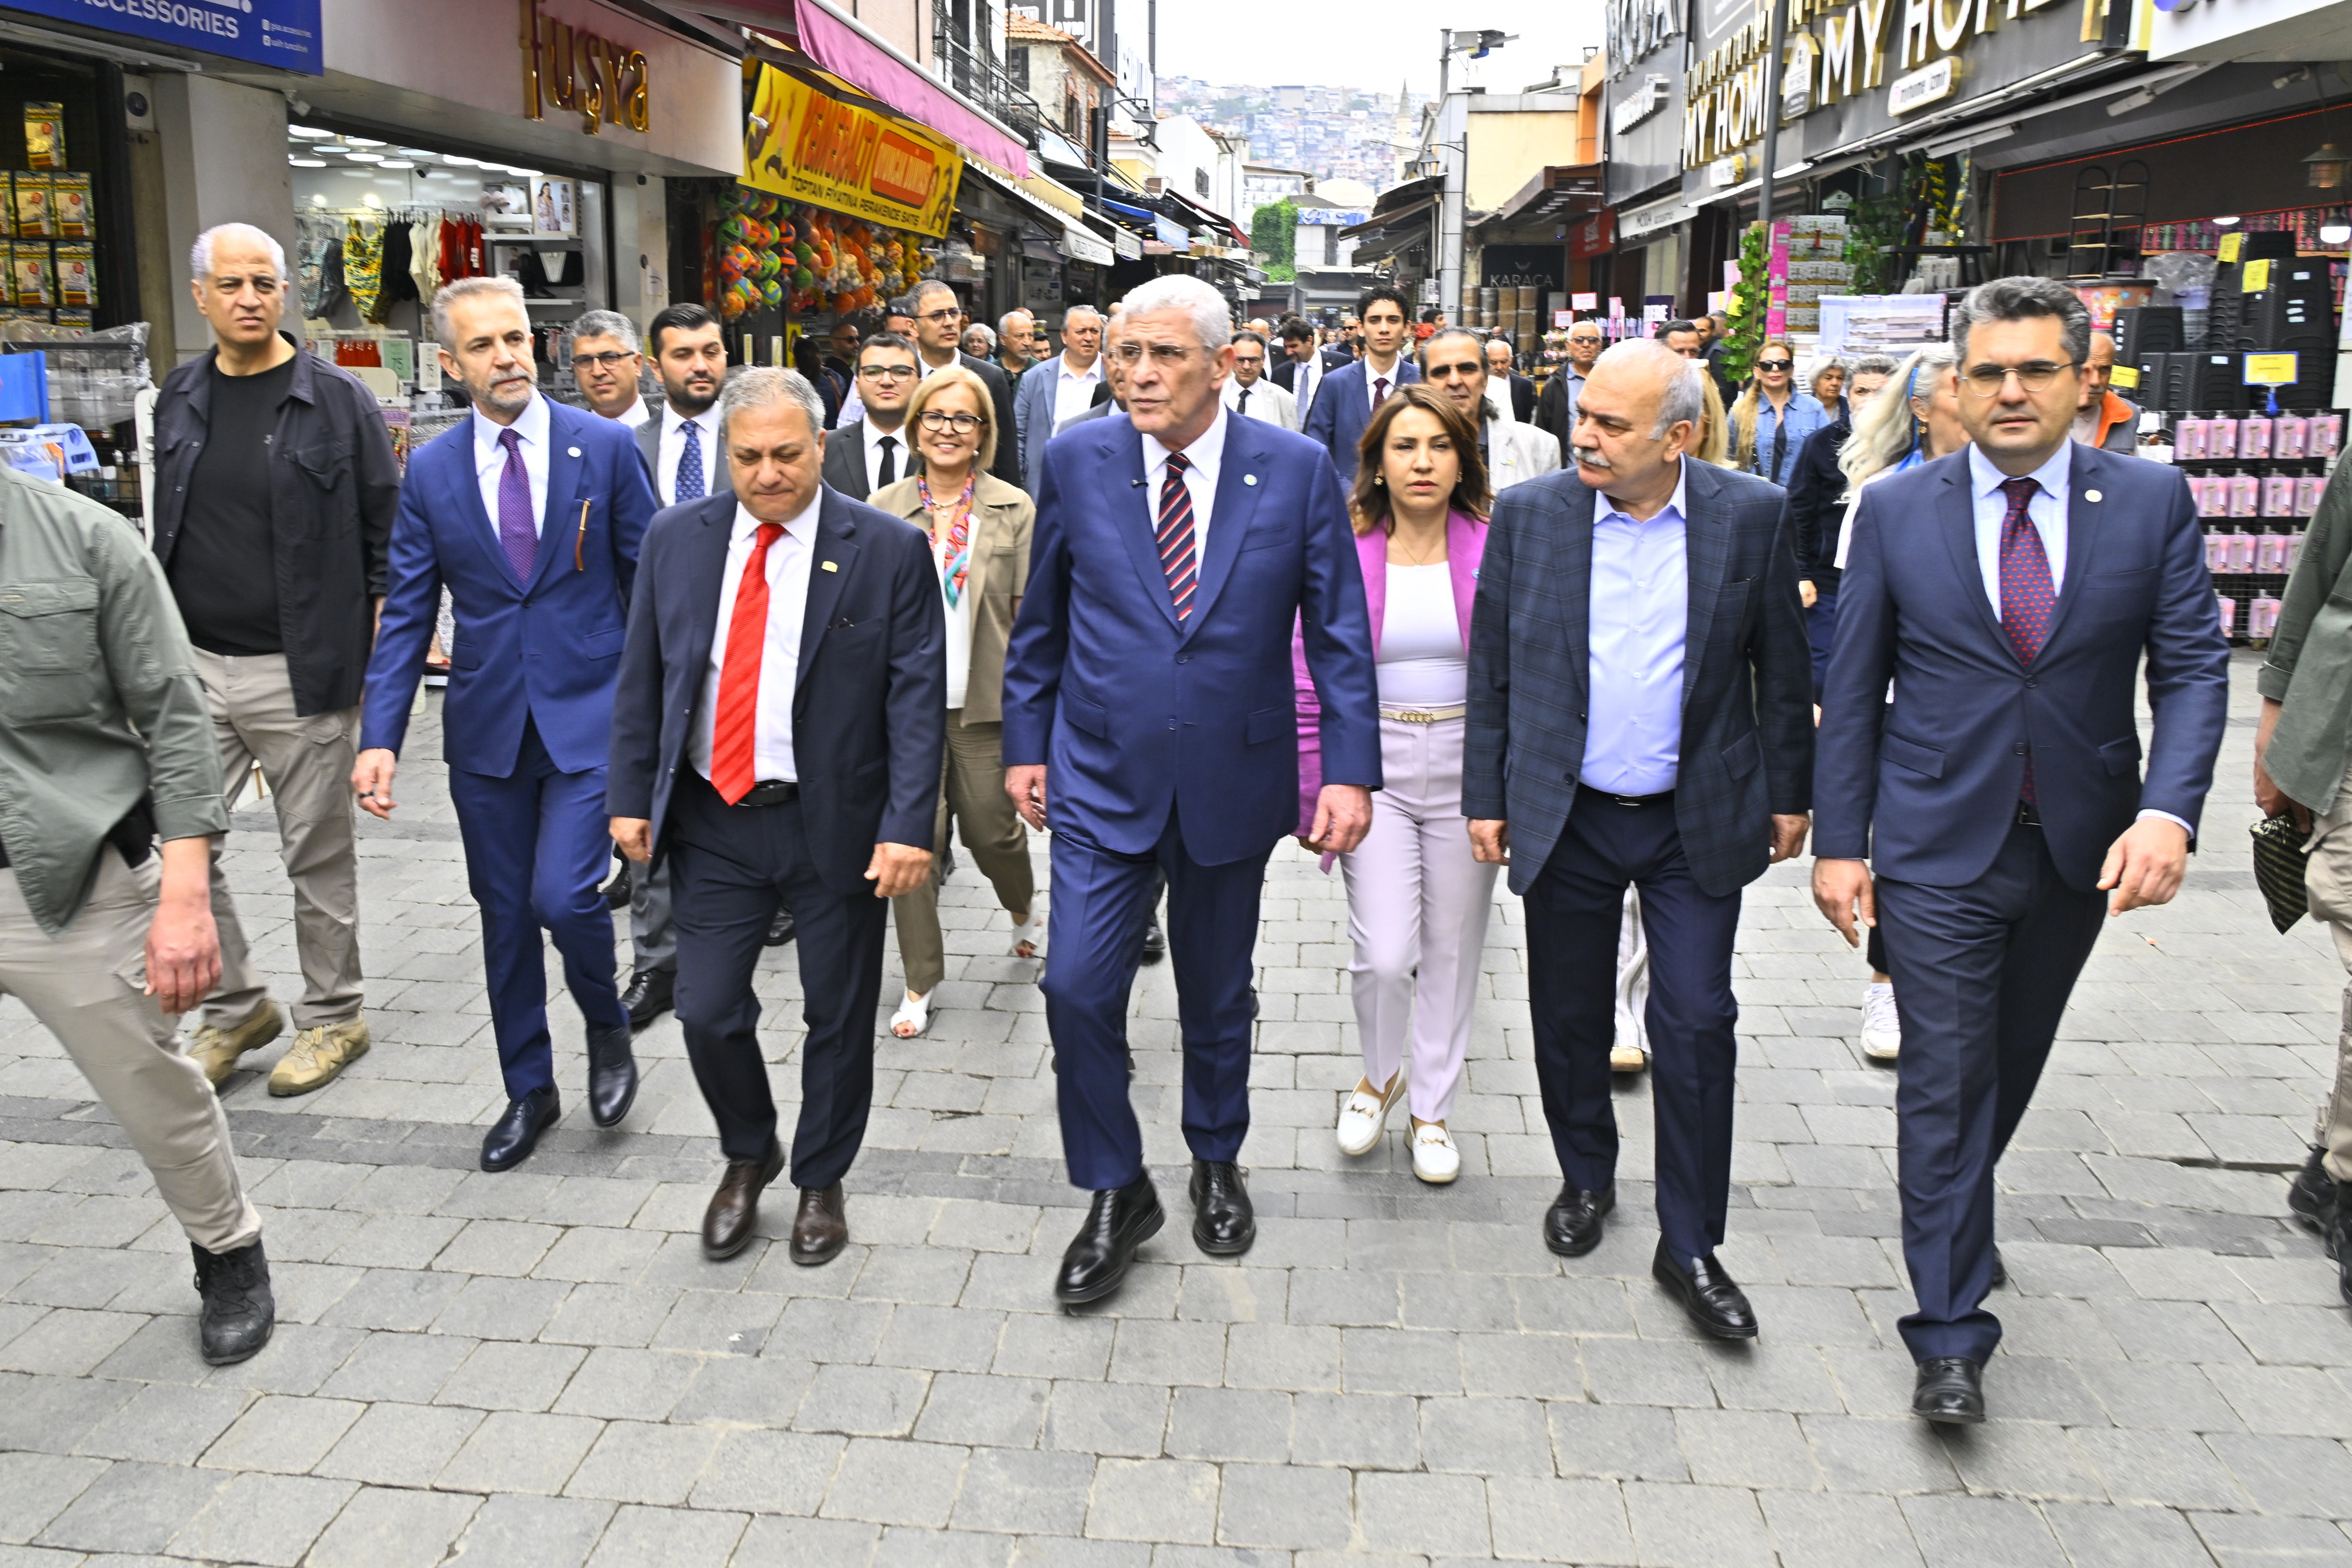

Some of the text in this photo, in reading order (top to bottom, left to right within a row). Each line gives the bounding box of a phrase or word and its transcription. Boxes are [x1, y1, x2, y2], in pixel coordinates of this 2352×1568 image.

[72, 0, 240, 38] CESSORIES
[1821, 0, 1887, 105] MY
[1900, 0, 2050, 70] HO
[1683, 93, 1711, 170] MY
[1244, 178, 1296, 191] PPY
[1490, 274, 1554, 287] KARACA
